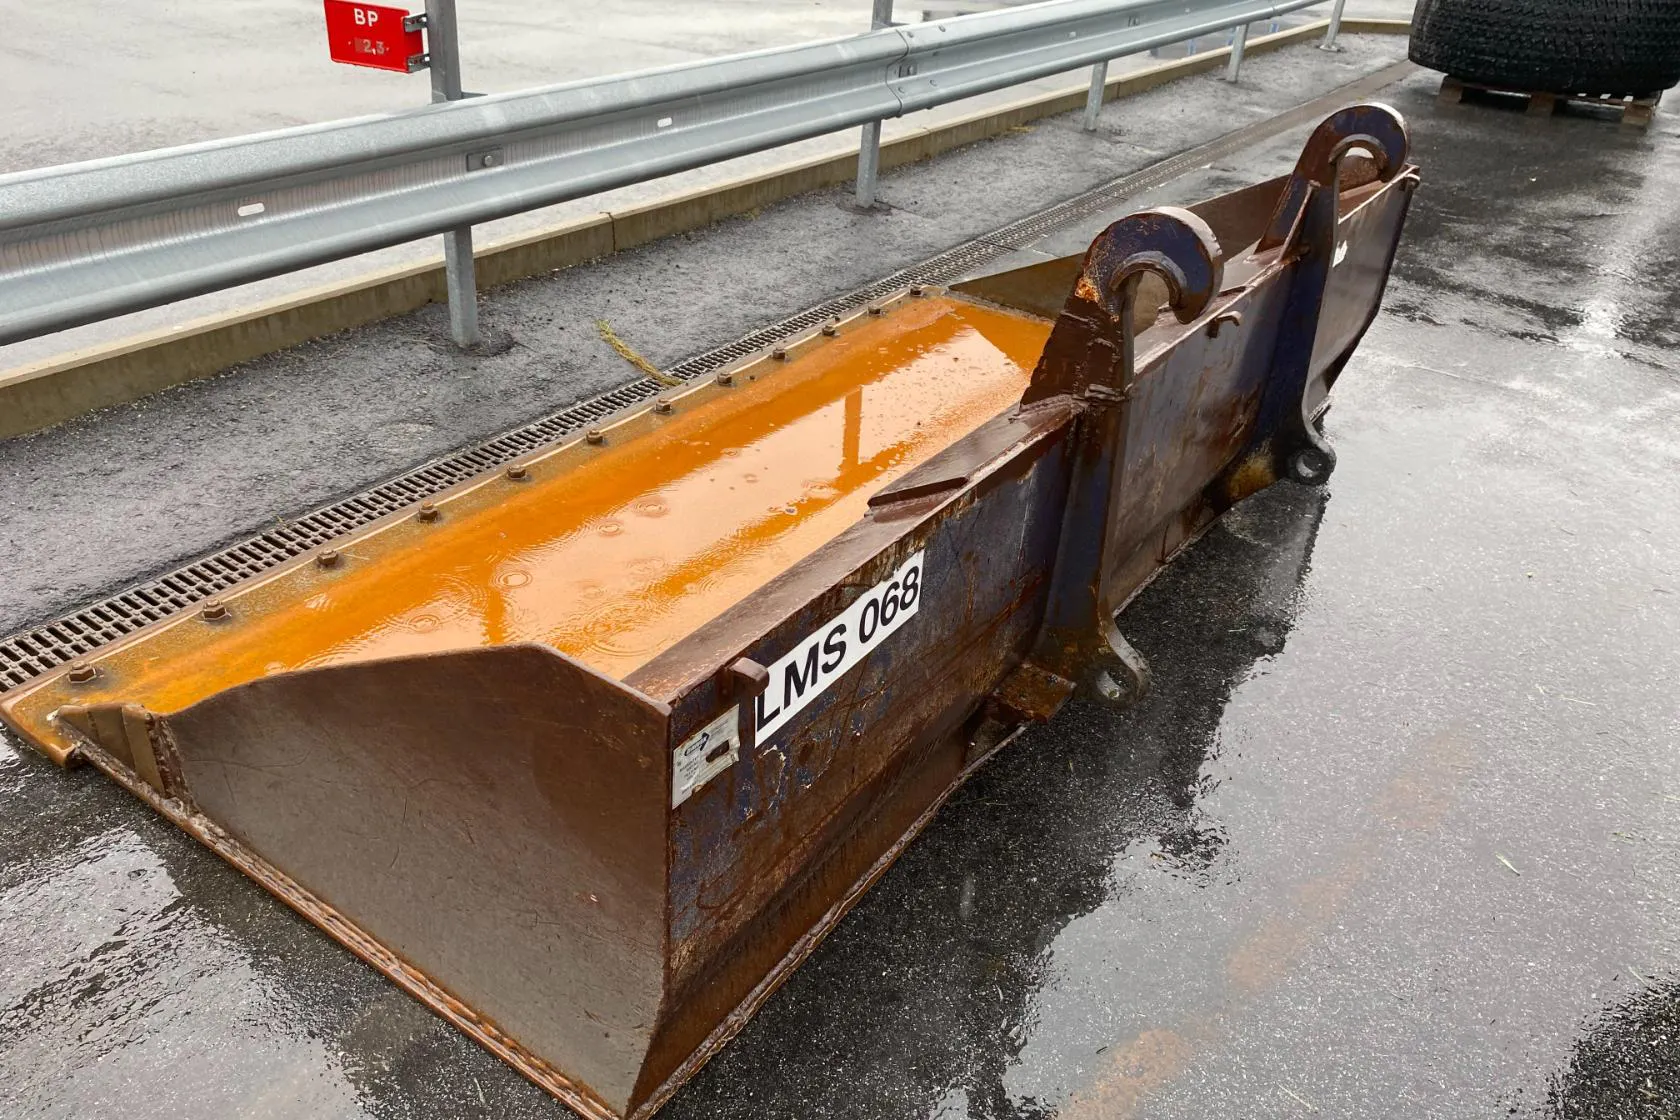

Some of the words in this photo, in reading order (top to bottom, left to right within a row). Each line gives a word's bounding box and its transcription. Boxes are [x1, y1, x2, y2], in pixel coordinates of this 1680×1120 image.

[354, 8, 378, 27] BP
[756, 623, 847, 732] LMS
[858, 565, 920, 644] 068
